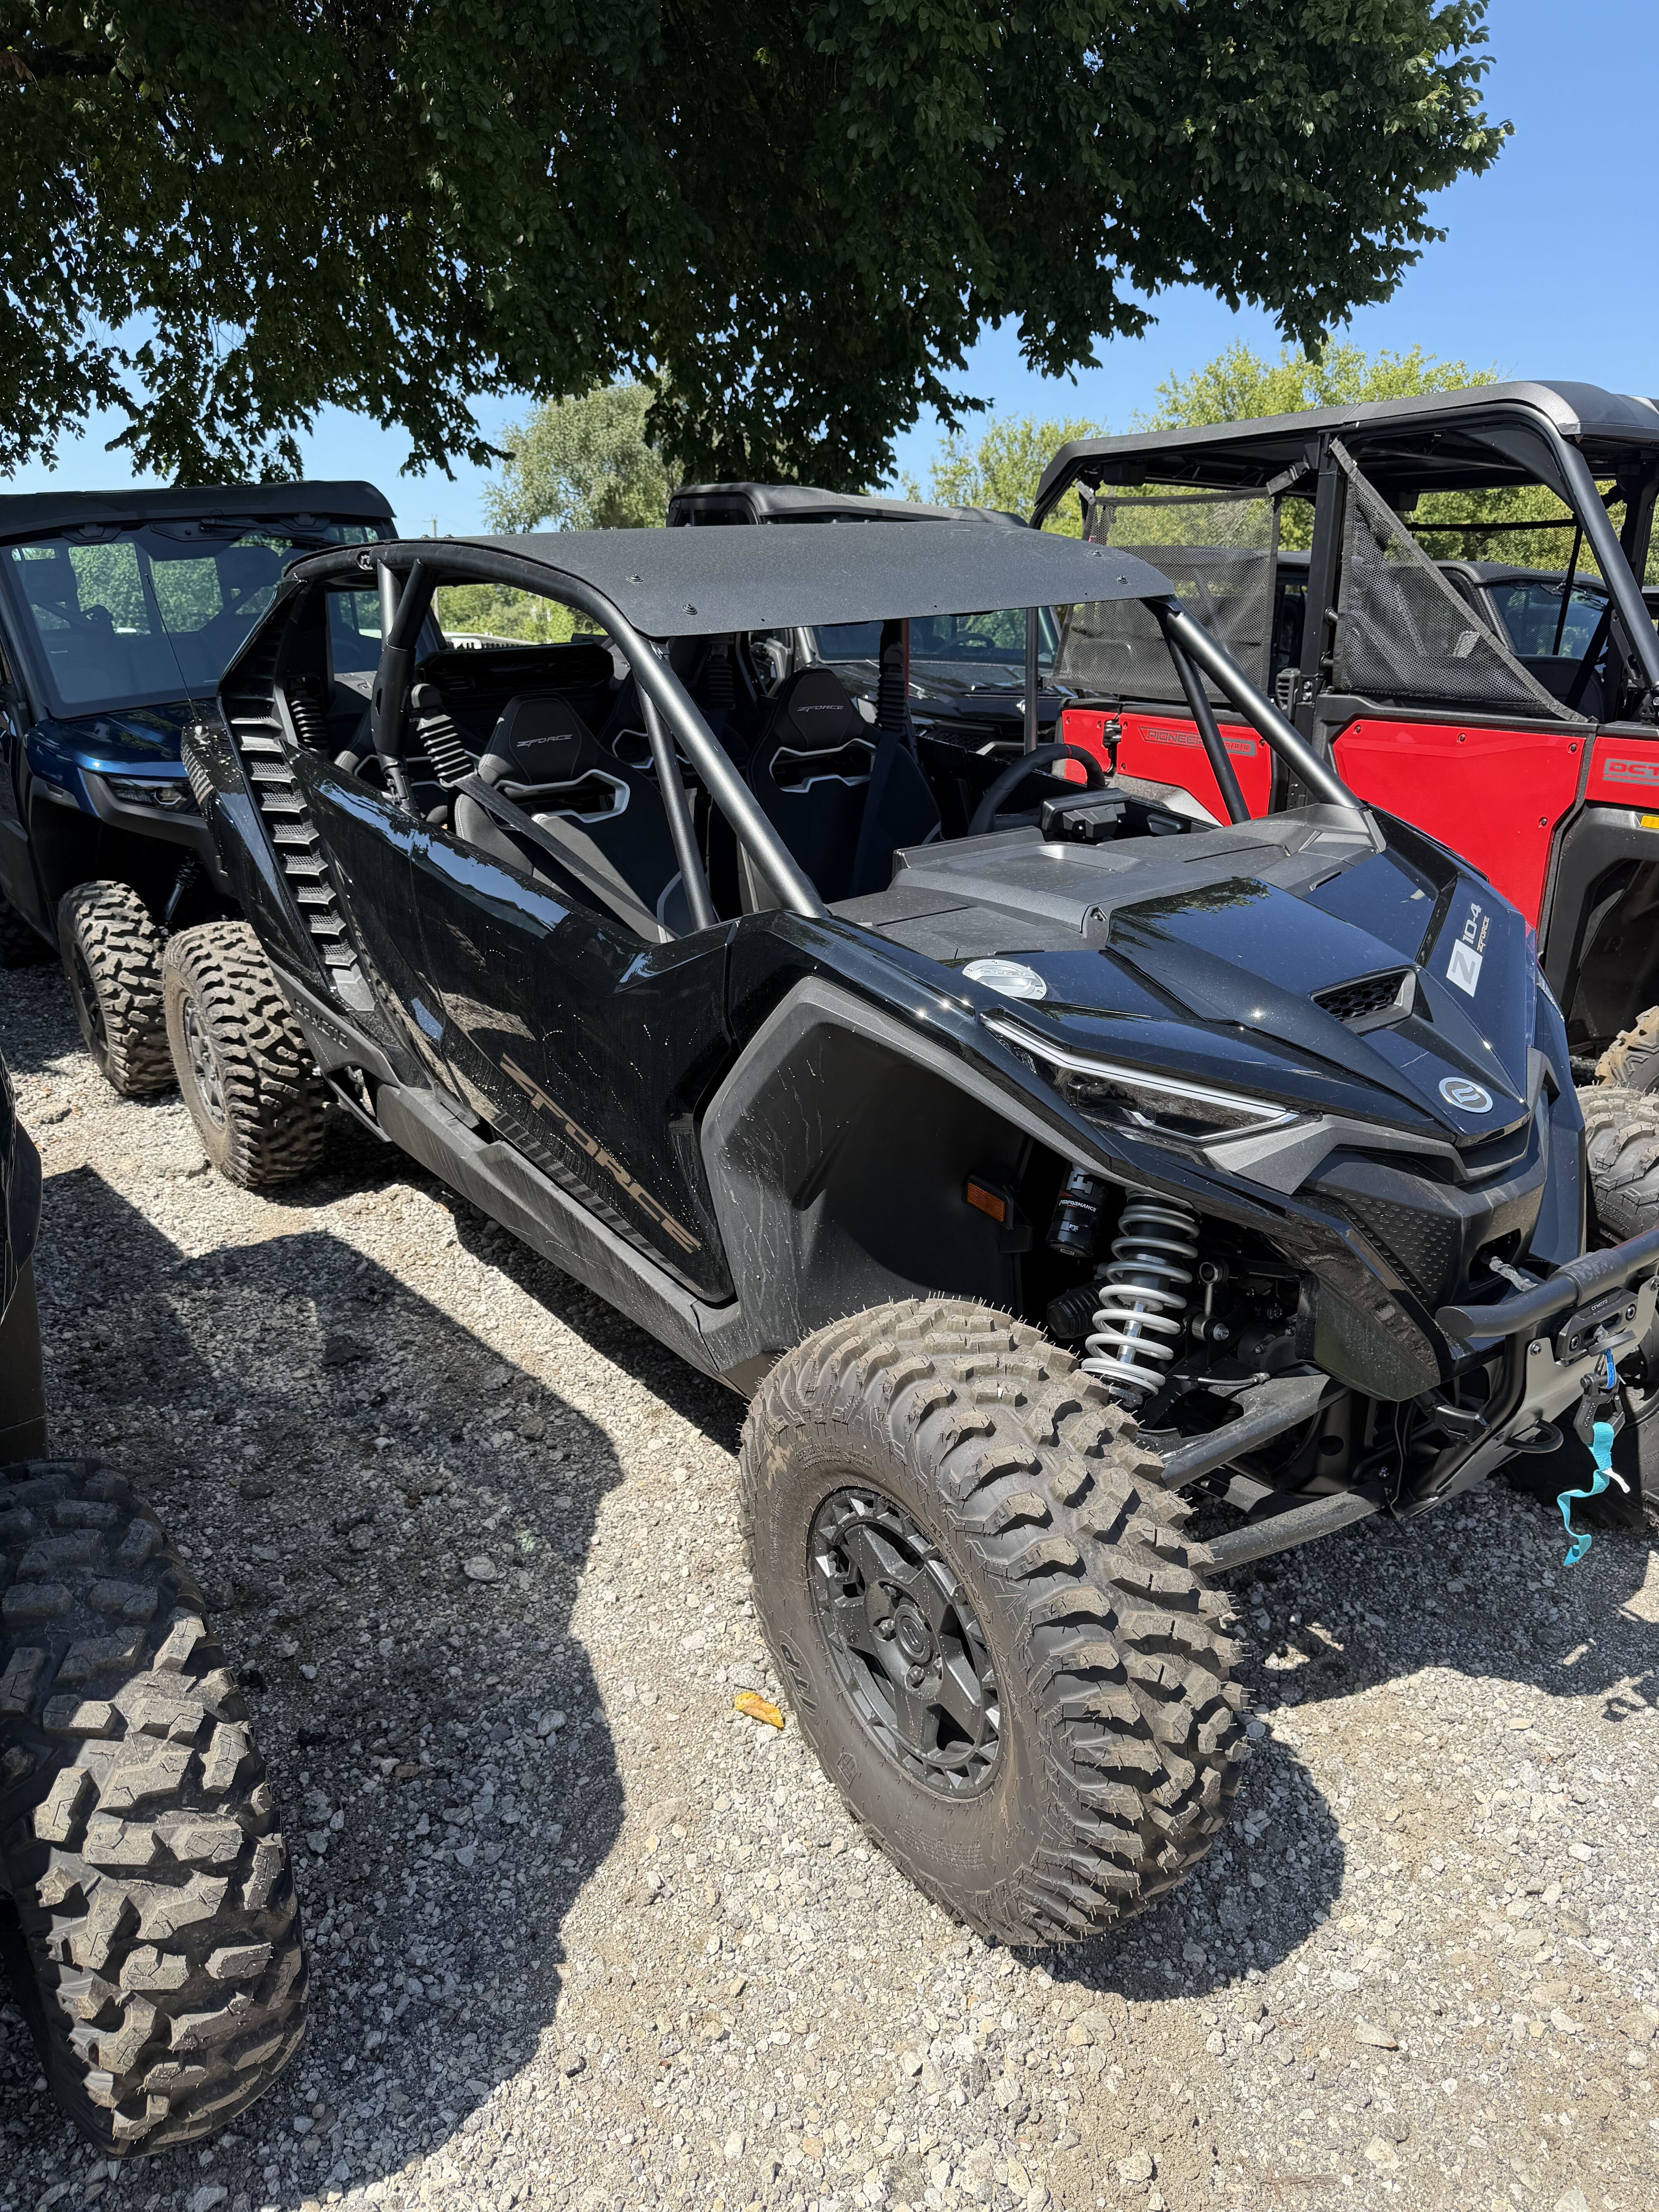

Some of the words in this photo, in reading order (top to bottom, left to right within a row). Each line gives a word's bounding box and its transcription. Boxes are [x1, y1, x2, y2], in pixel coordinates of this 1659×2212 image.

[517, 734, 573, 747] ZFORCE
[1223, 740, 1251, 752] 000
[1462, 903, 1482, 944] 10-4
[1477, 916, 1490, 952] ZFORCE
[500, 1053, 701, 1254] ZFORCE
[1059, 1200, 1096, 1212] PERFORMANCE
[780, 1643, 817, 1712] ITP
